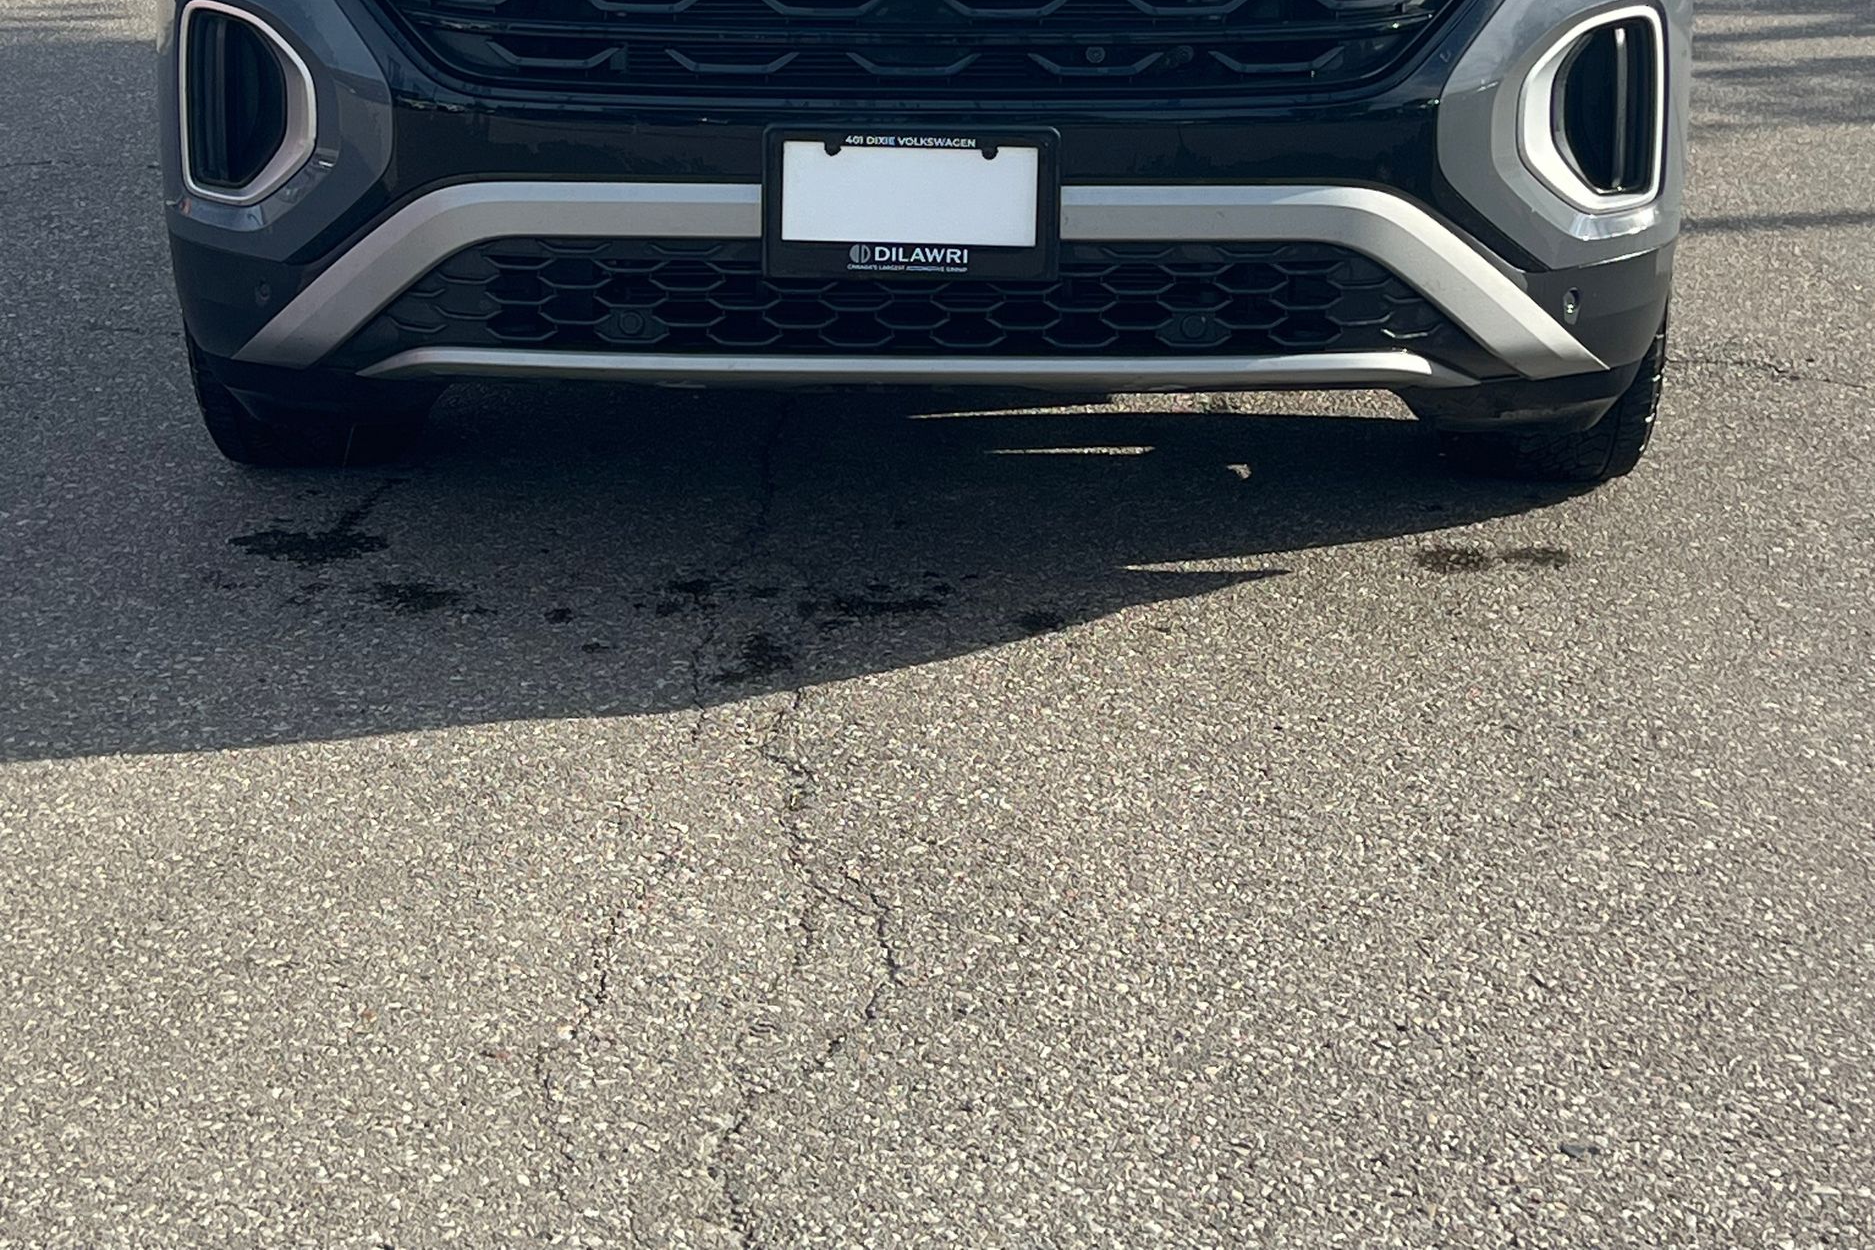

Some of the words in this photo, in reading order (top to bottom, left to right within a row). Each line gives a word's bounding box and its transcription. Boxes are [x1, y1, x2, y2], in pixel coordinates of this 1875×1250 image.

[845, 135, 864, 145] 401
[866, 136, 896, 146] DIXIE
[897, 136, 977, 148] VOLKSWAGEN
[874, 246, 968, 264] DILAWRI
